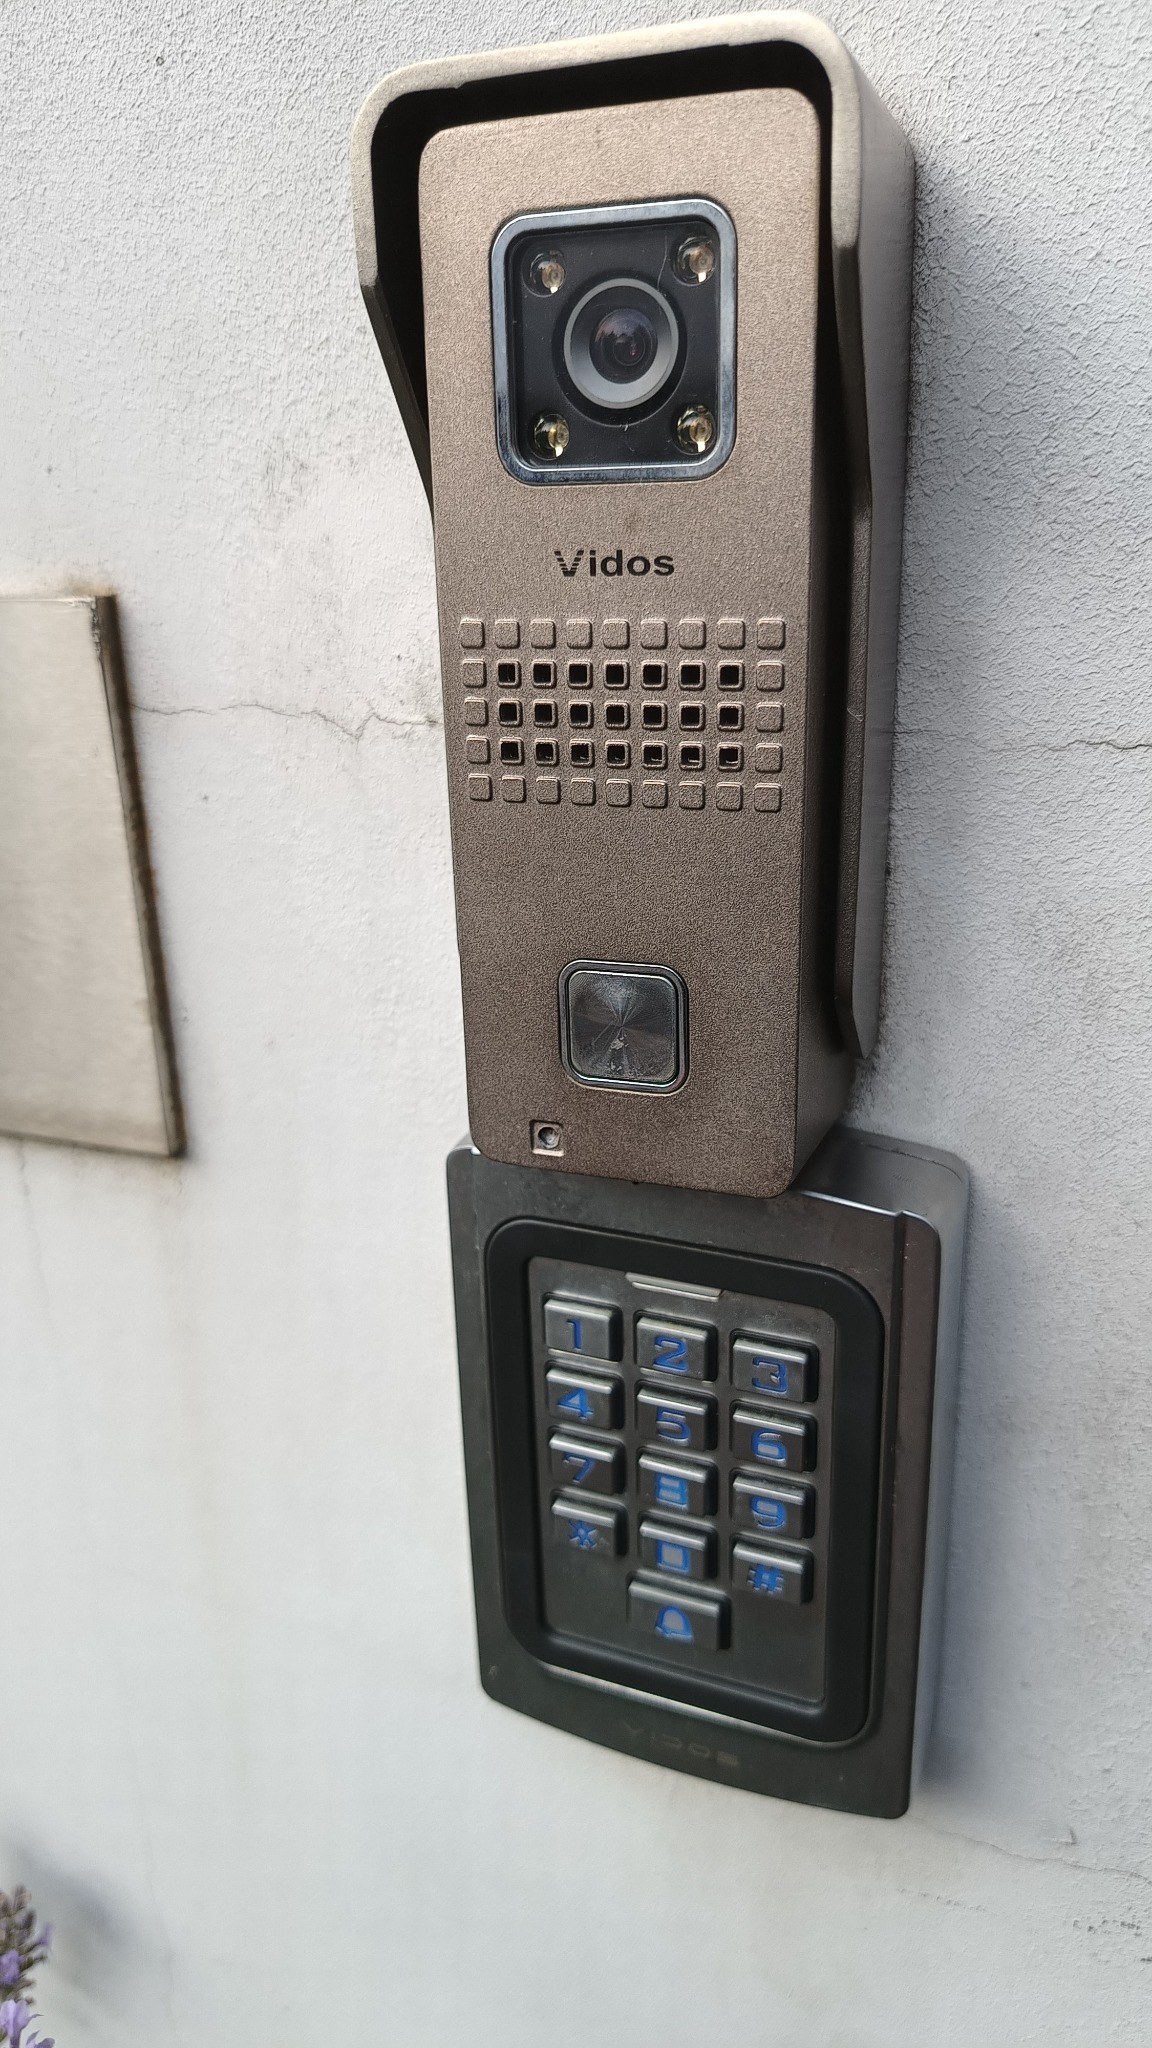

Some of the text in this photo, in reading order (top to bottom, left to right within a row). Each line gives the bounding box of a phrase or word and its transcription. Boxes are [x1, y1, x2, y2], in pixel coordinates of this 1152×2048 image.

[554, 549, 675, 577] Vidos
[567, 1319, 582, 1350] 1
[653, 1335, 689, 1372] 2
[752, 1356, 788, 1393] 3
[558, 1387, 593, 1420] 4
[656, 1406, 690, 1445] 5
[751, 1430, 787, 1466] 6
[563, 1453, 594, 1483] 7
[655, 1473, 688, 1509] 8
[751, 1496, 787, 1529] 9
